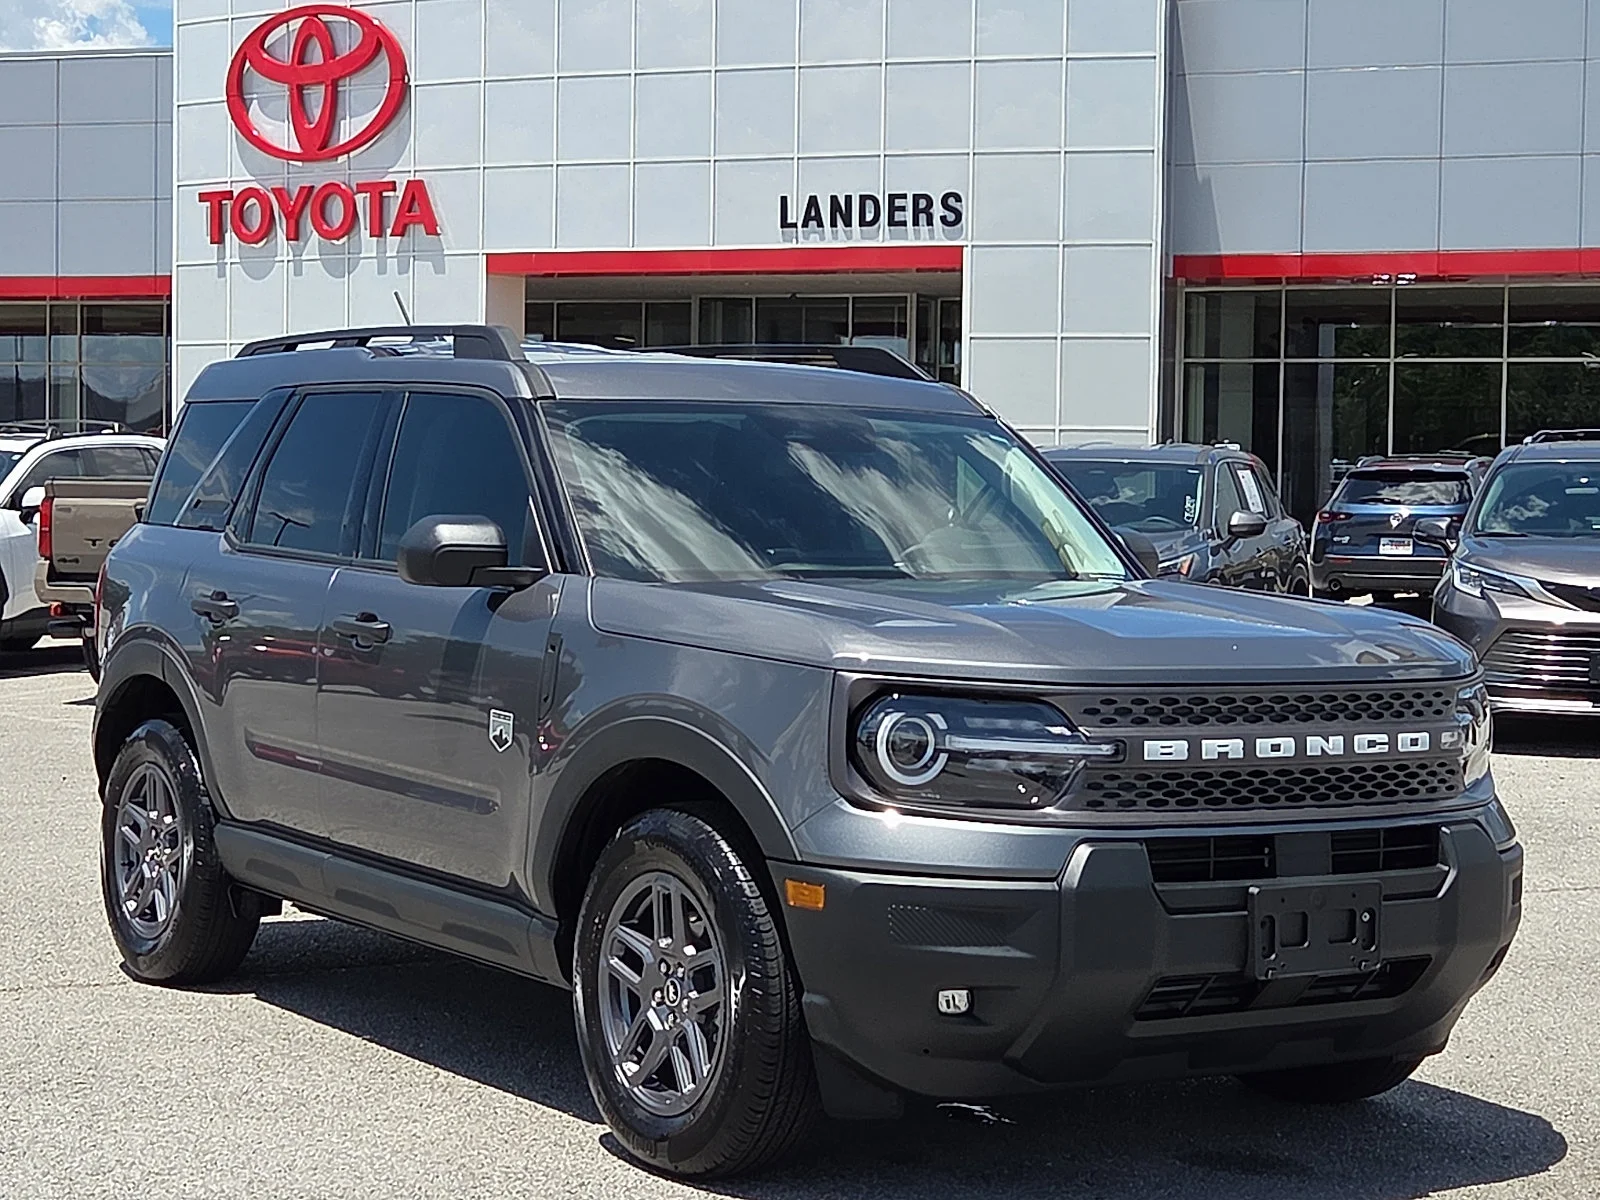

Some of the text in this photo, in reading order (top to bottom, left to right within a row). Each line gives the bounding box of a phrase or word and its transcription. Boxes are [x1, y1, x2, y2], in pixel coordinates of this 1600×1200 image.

[198, 179, 441, 245] TOYOTA
[779, 191, 963, 229] LANDERS
[1143, 731, 1430, 761] BRONCO
